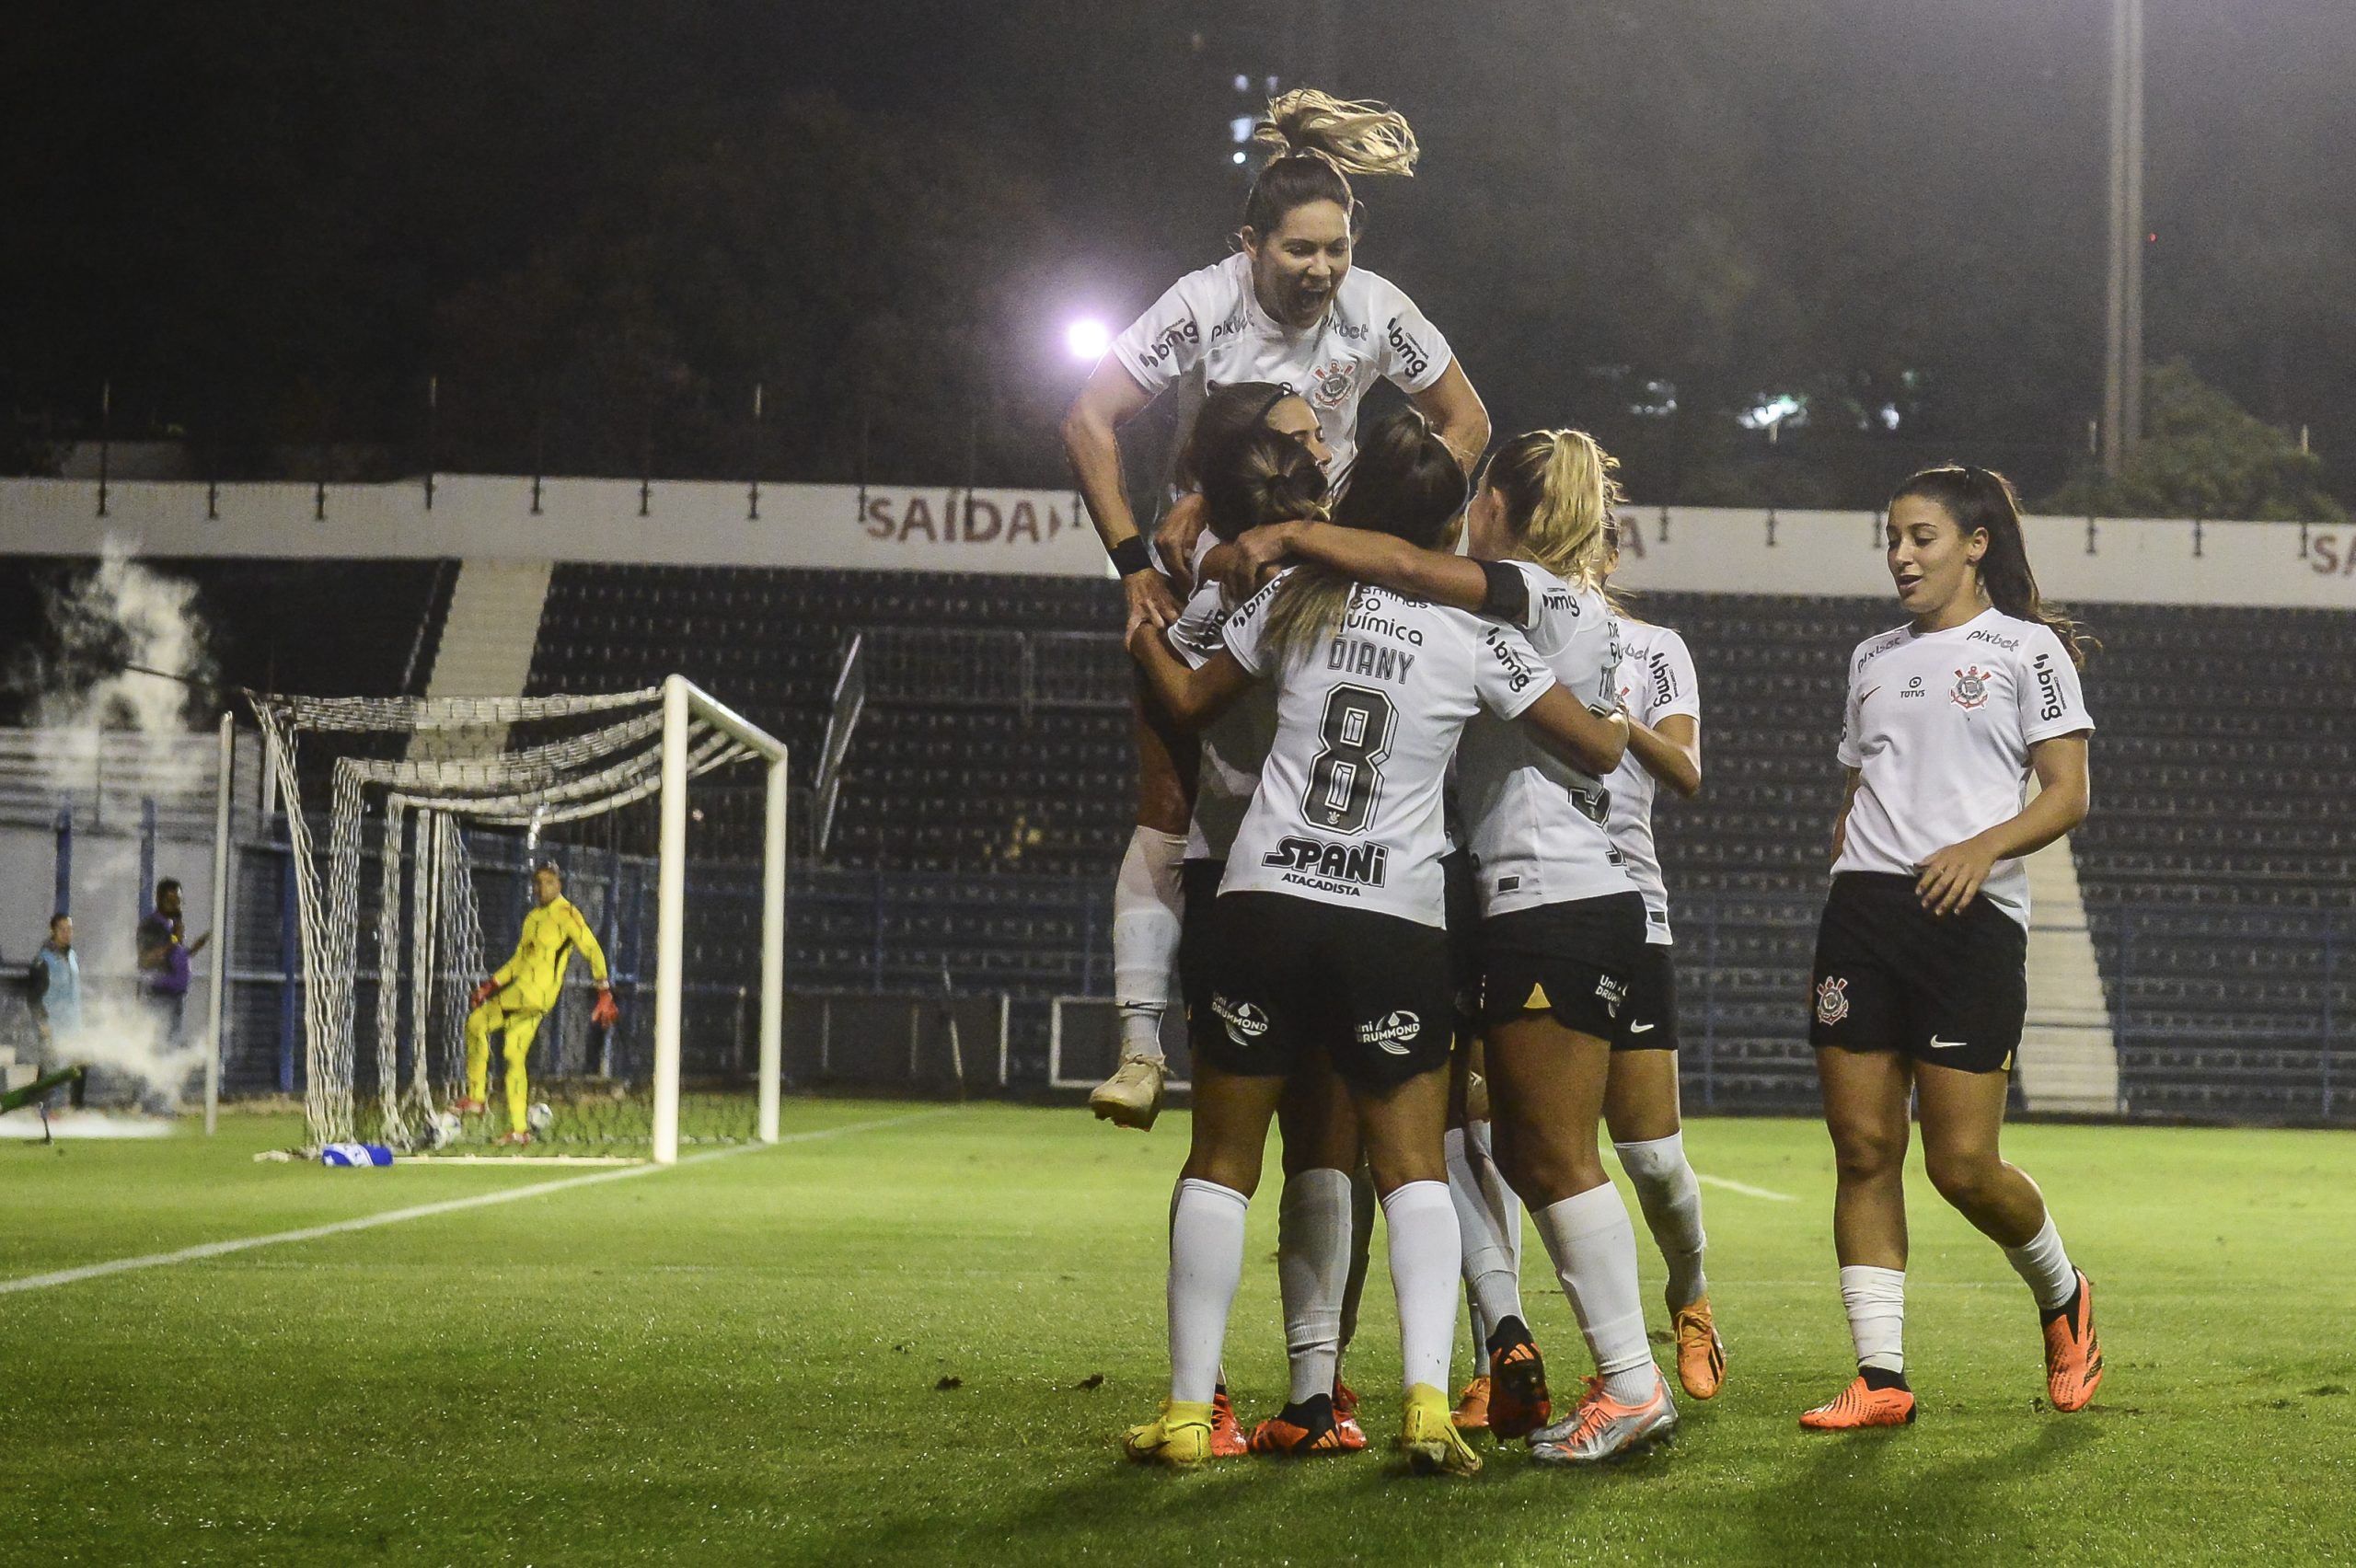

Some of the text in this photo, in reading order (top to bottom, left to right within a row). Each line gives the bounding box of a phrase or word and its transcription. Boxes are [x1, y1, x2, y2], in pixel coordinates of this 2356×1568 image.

[1390, 327, 1427, 378] bmg
[1340, 611, 1424, 647] uímica
[1966, 628, 2019, 652] pixbet
[1326, 635, 1415, 685] DIANY
[1493, 640, 1530, 693] bmg
[1652, 663, 1672, 708] bmg
[1900, 689, 1925, 699] TOTVS
[2037, 668, 2062, 721] bmg
[1299, 682, 1400, 836] 8
[1281, 872, 1361, 897] ATACADISTA
[1211, 1001, 1268, 1032] DRUMMOND
